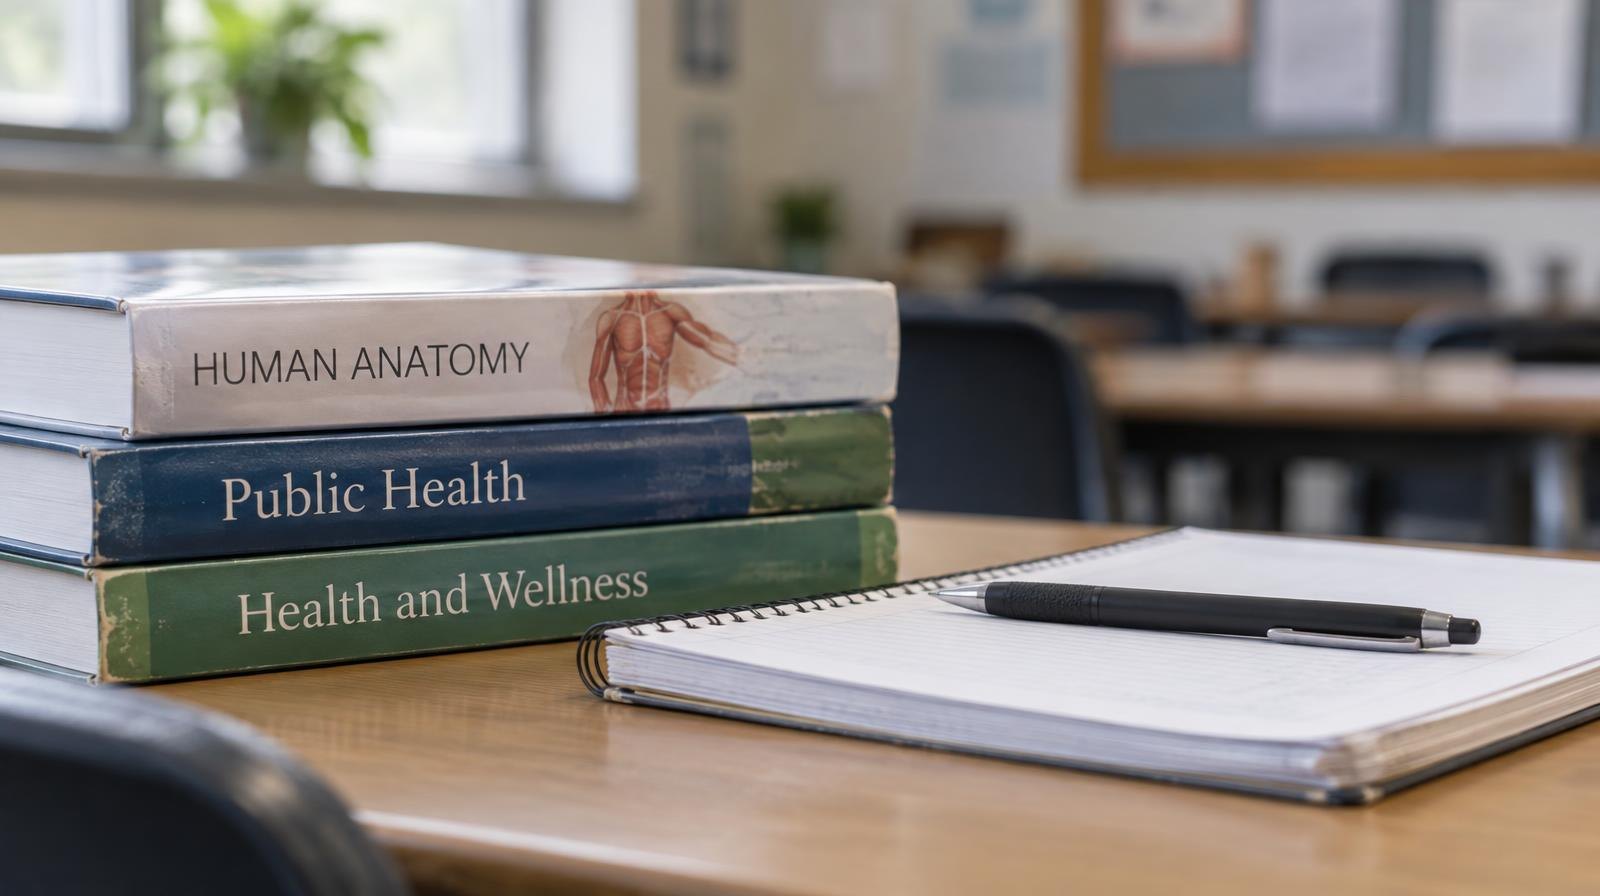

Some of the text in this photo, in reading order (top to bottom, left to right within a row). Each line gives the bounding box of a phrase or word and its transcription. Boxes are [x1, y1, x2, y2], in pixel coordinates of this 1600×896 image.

[193, 341, 530, 386] HUMAN ANATOMY
[221, 459, 527, 522] Public Health
[237, 563, 649, 636] Health and Wellness
